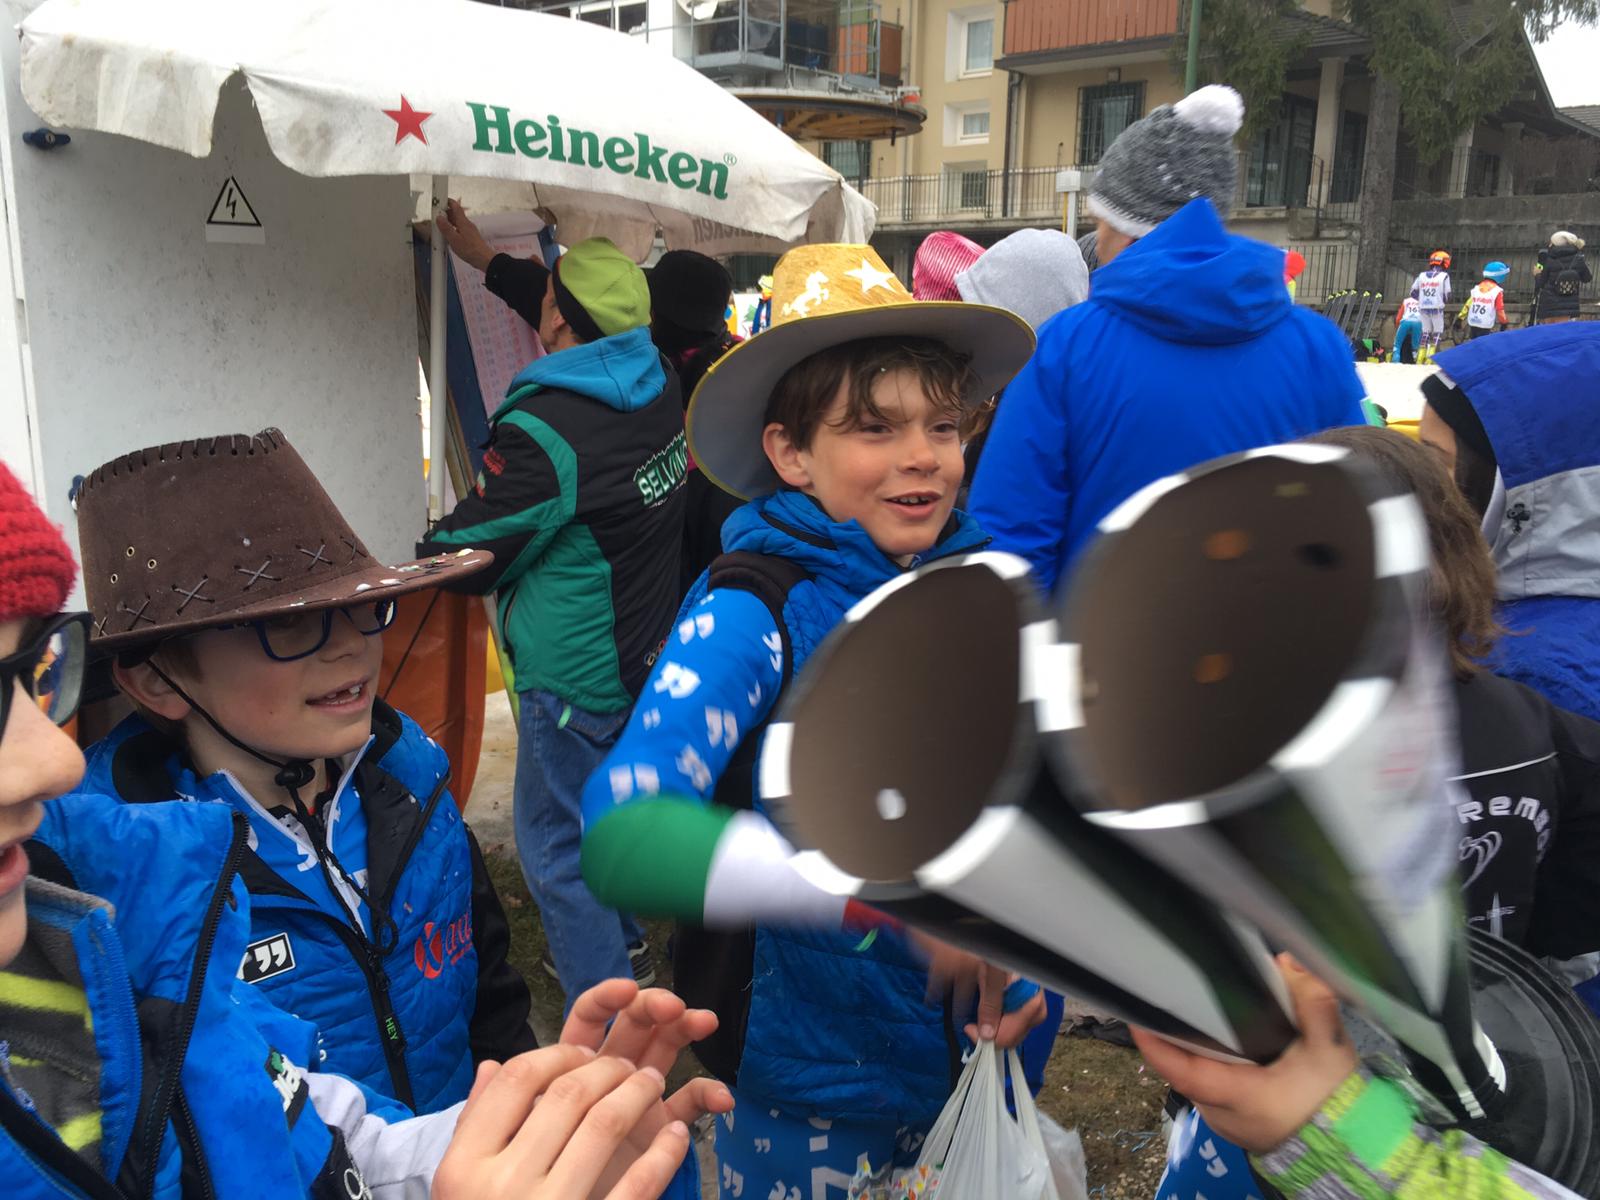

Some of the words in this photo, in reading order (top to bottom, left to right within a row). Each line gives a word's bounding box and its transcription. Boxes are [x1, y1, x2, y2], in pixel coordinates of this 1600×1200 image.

[466, 101, 730, 199] Heineken
[1422, 288, 1436, 298] 162
[1472, 304, 1487, 315] 176
[385, 1016, 399, 1040] HEY
